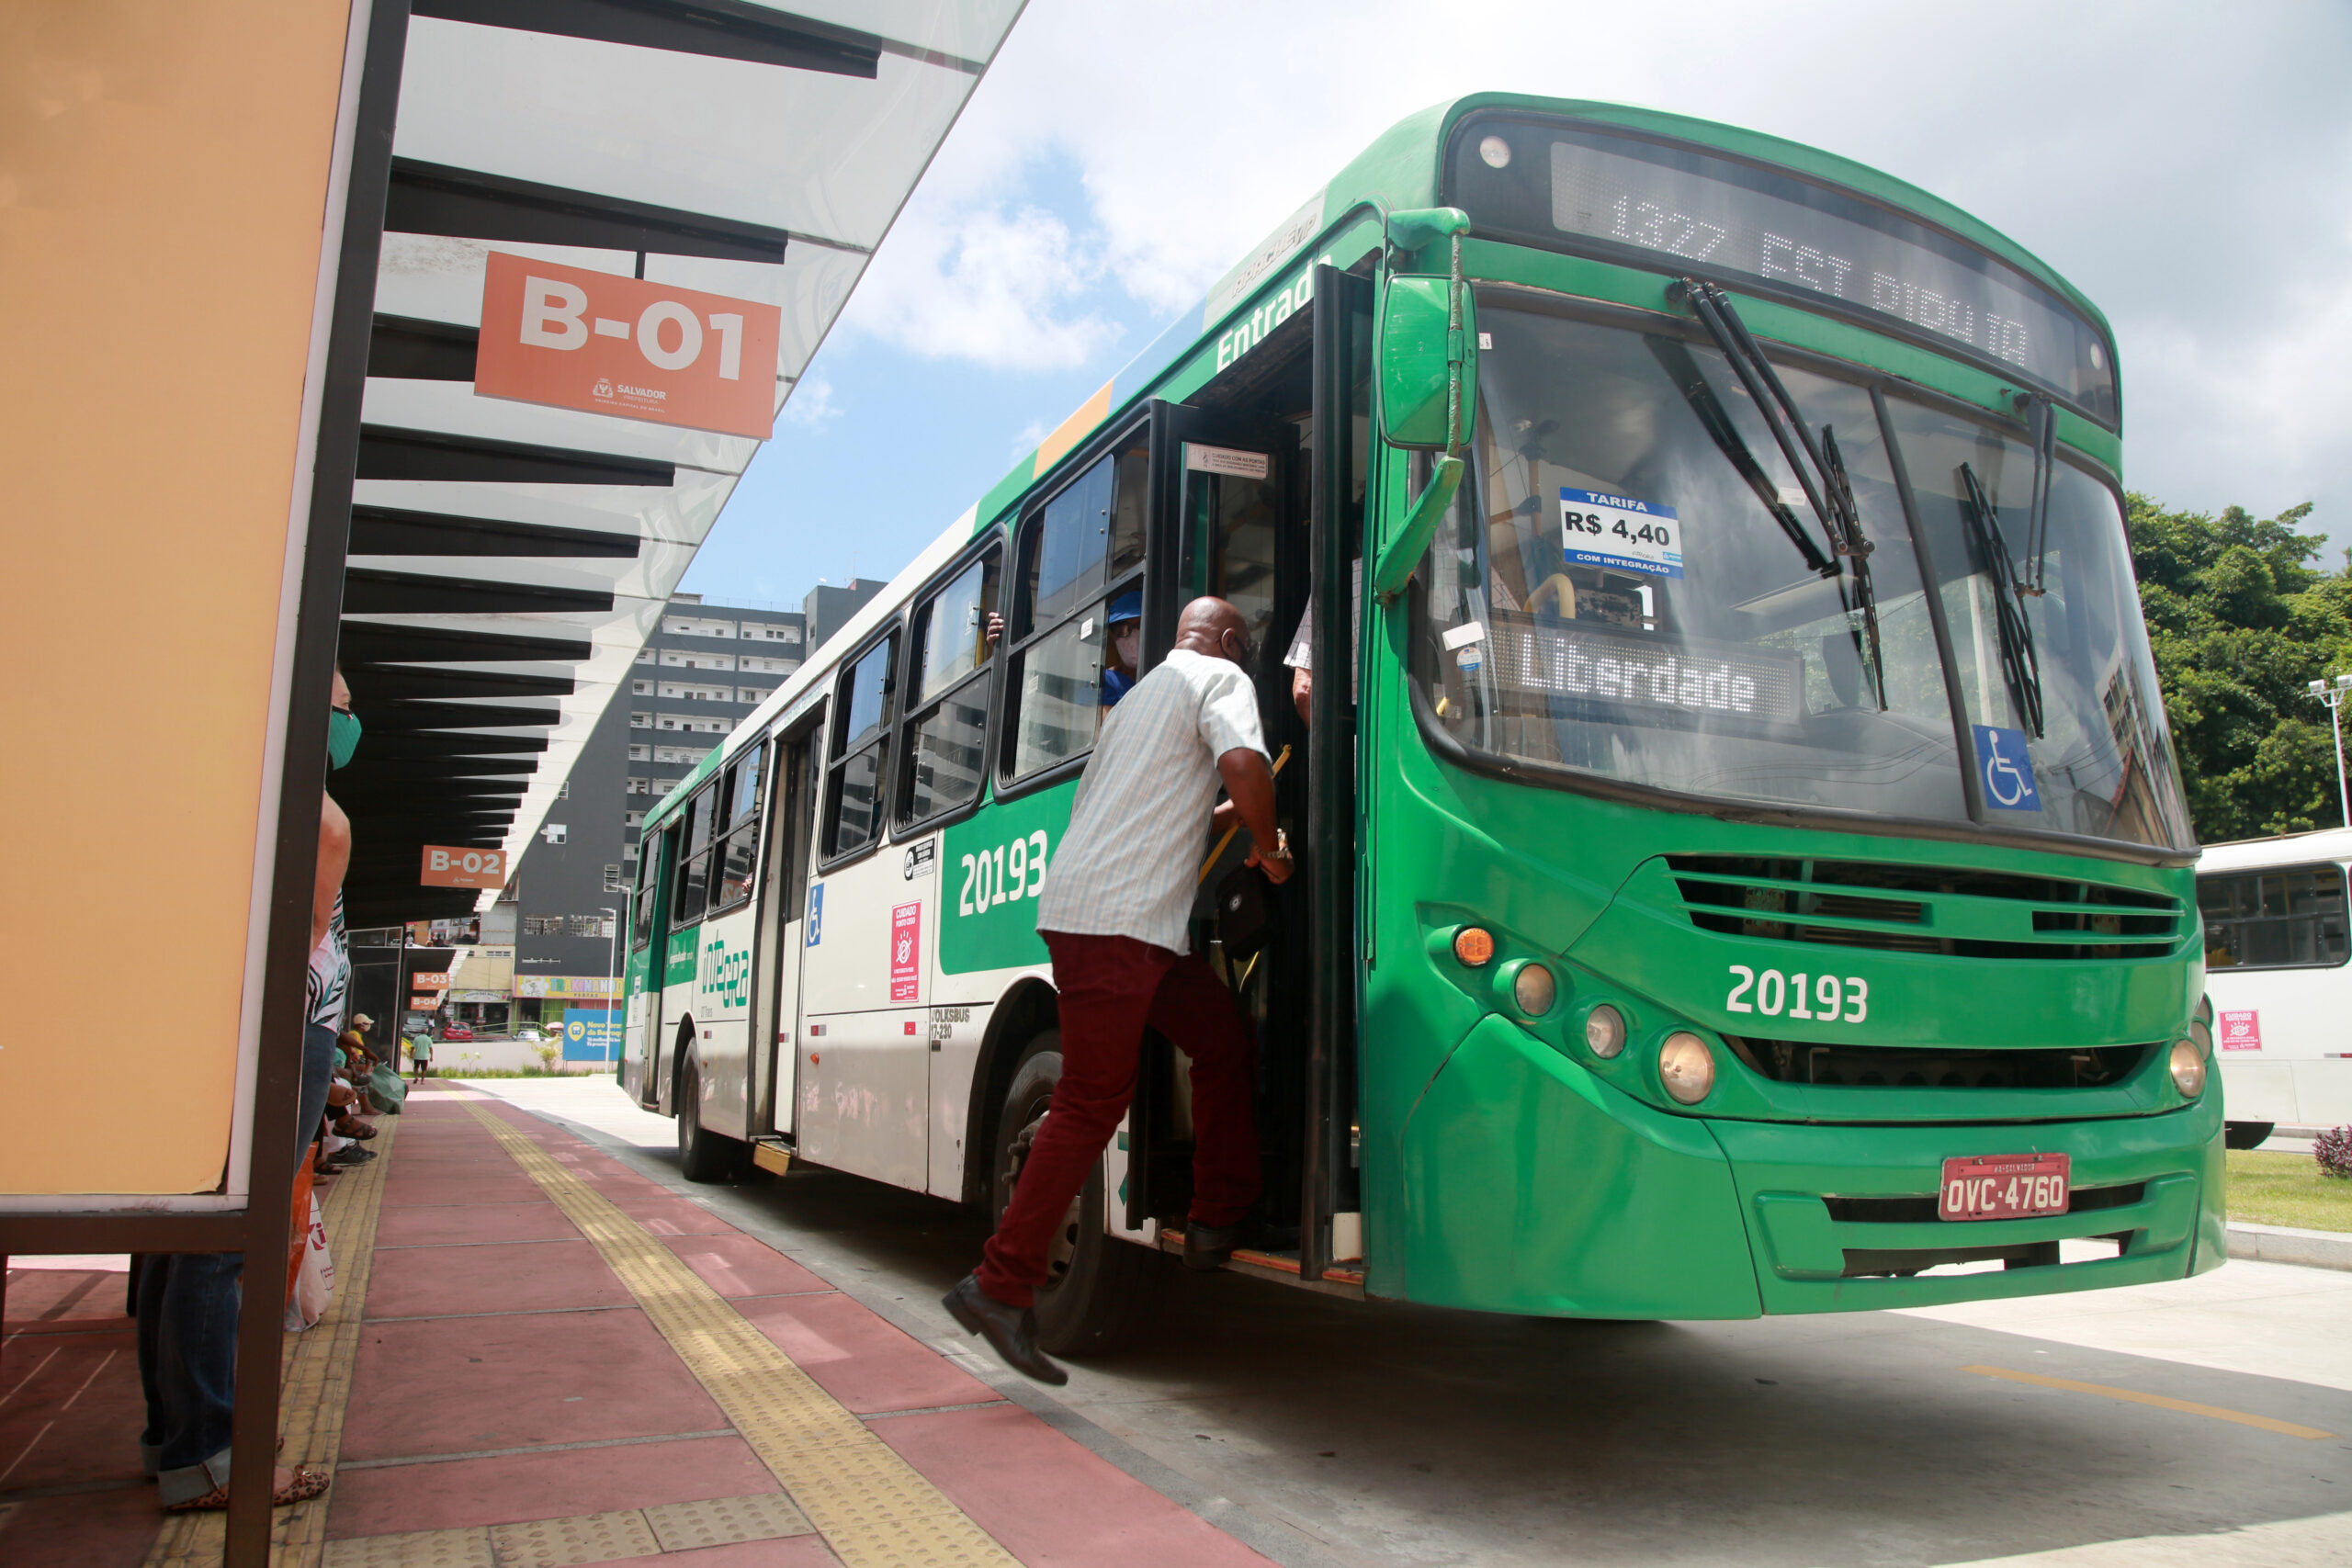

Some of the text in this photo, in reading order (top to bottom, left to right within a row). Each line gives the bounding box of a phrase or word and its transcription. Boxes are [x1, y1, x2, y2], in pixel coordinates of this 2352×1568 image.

[1611, 194, 1726, 264] 1327
[1216, 254, 1332, 375] Entrad
[519, 275, 744, 381] B-01
[616, 384, 667, 400] SALVADOR
[1586, 491, 1648, 513] TARIFA
[1565, 511, 1670, 547] R$ 4,40
[1576, 552, 1601, 563] COM
[1602, 556, 1670, 574] INTEGRAÇÃO
[1521, 633, 1756, 713] Liberdade
[429, 850, 501, 874] B-02
[958, 829, 1047, 918] 20193
[896, 905, 917, 919] CUIDADO
[416, 974, 448, 985] B-03
[413, 998, 437, 1007] B-04
[1725, 964, 1869, 1024] 20193
[931, 1022, 953, 1039] 17-230
